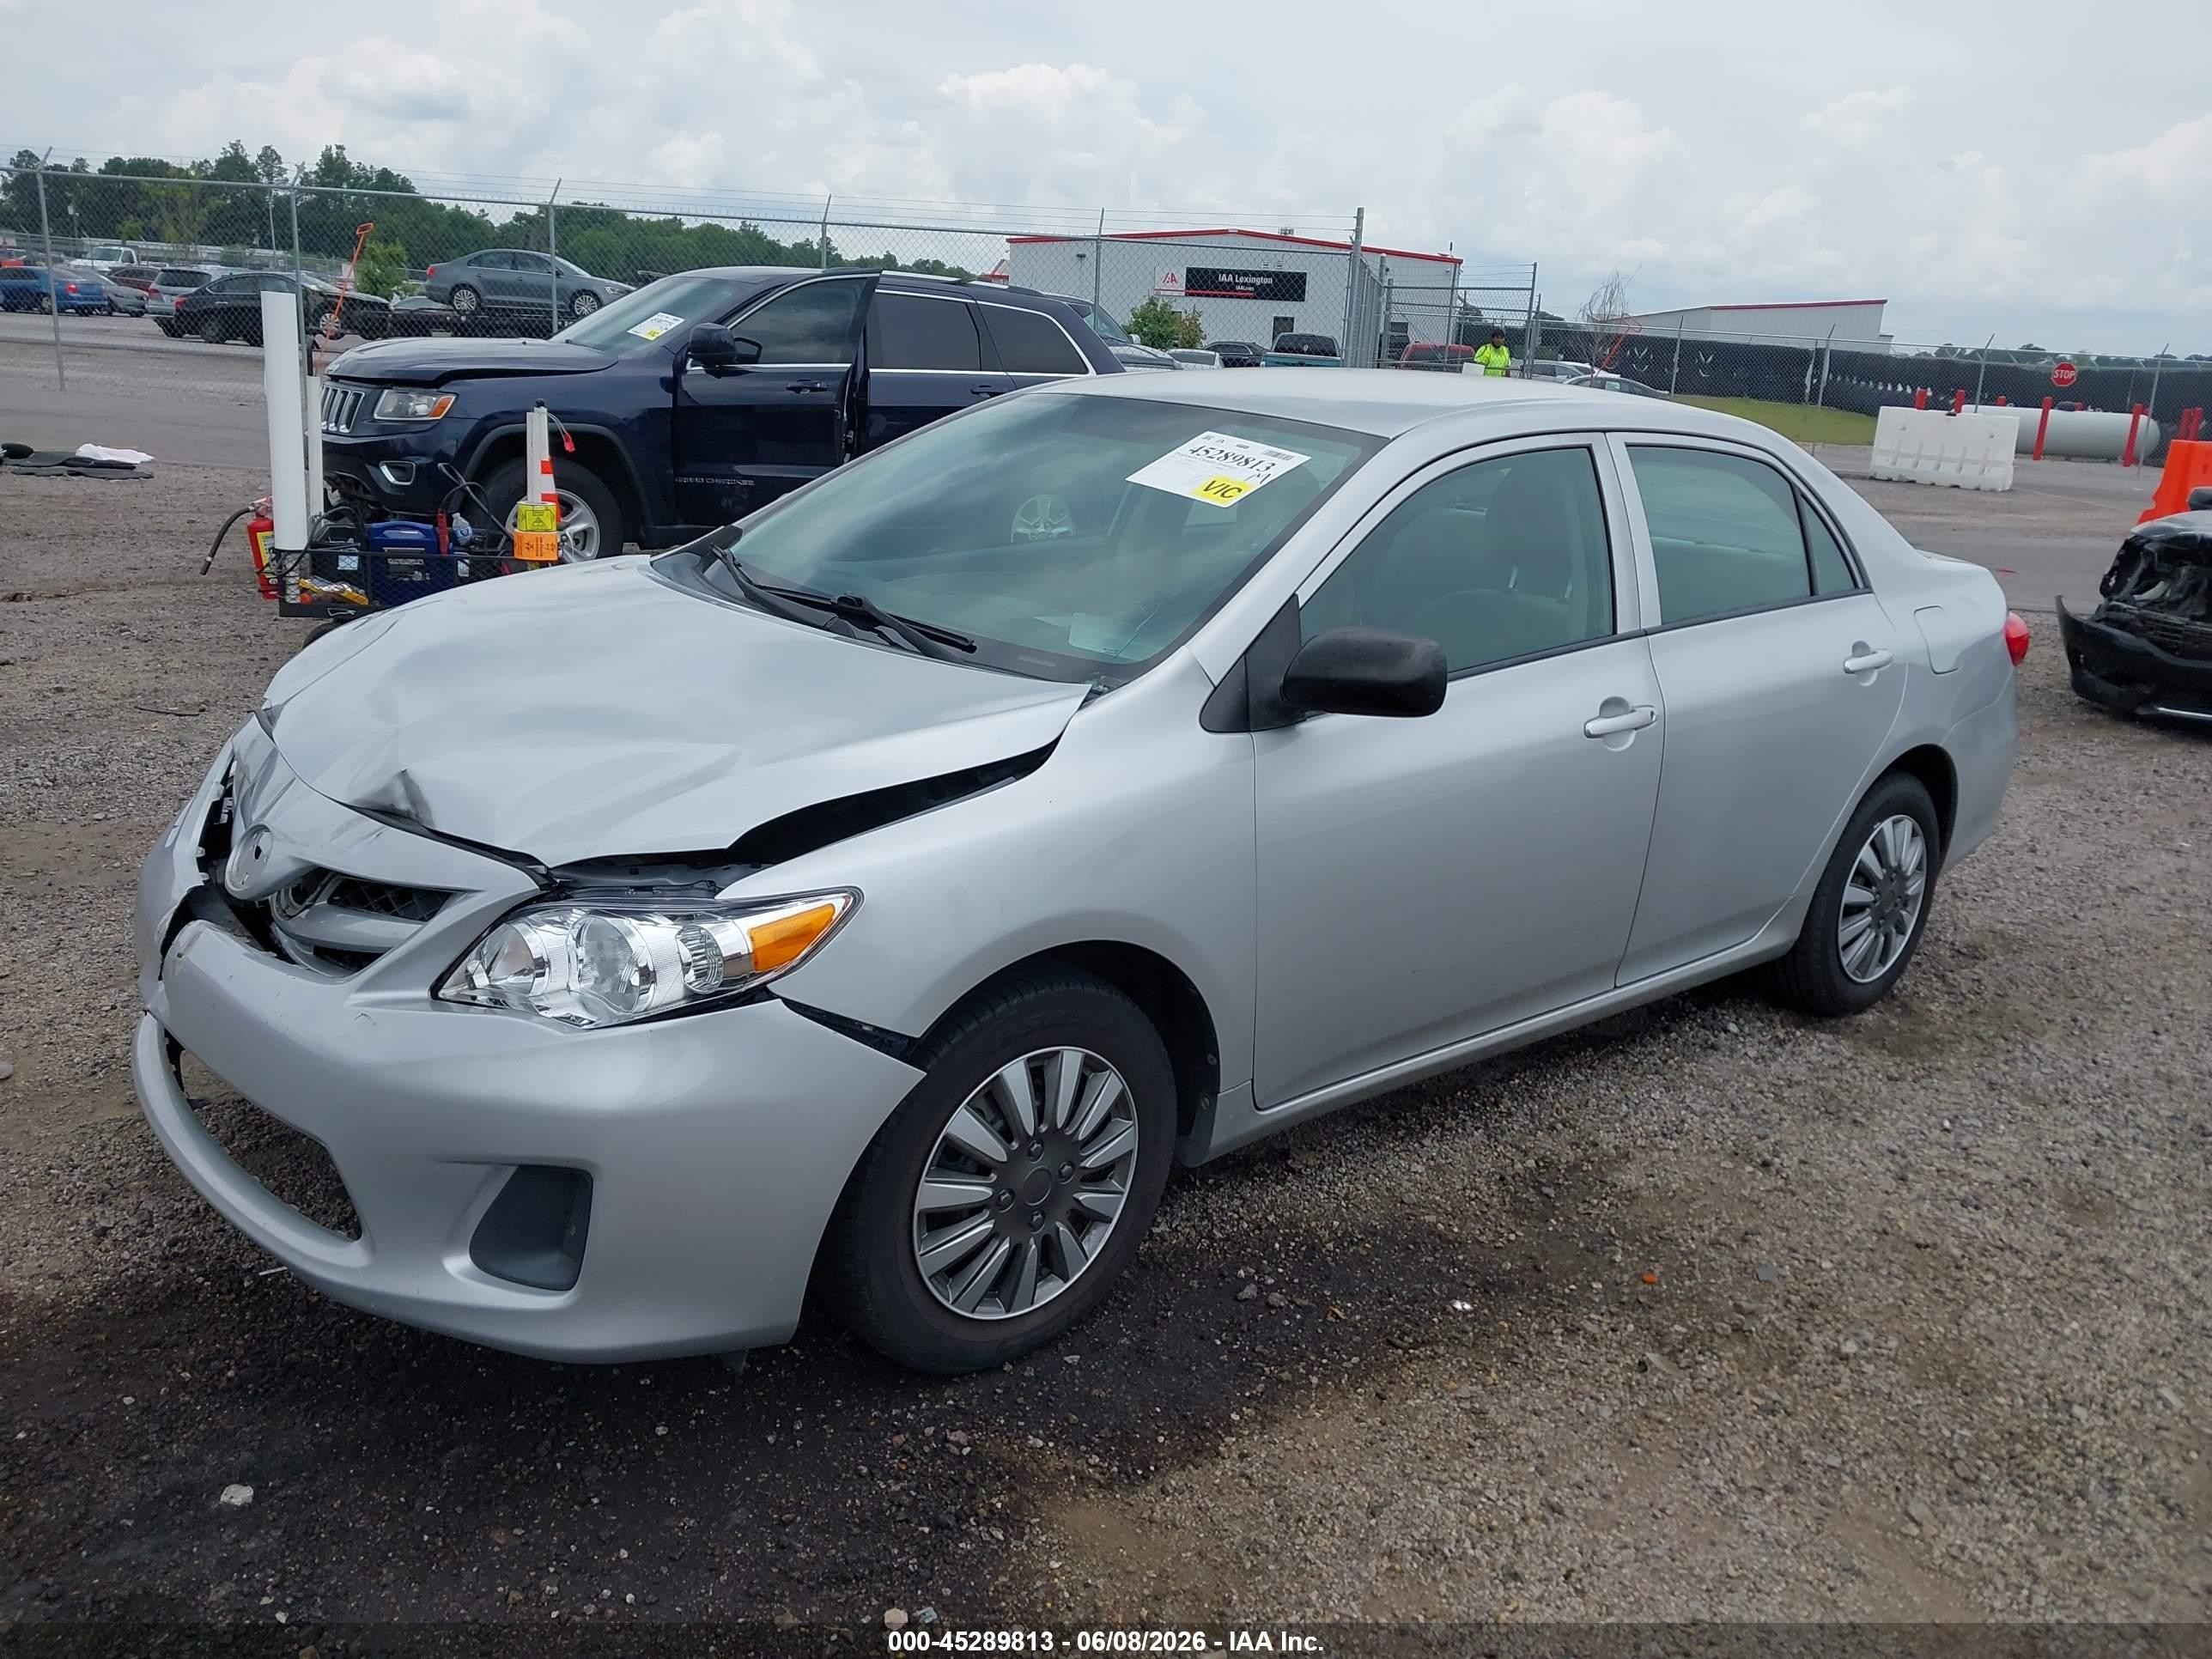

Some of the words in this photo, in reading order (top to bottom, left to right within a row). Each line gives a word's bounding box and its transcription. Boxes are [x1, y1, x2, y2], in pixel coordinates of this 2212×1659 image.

[1218, 274, 1234, 283] IAA
[1236, 275, 1273, 285] Lexington
[2053, 369, 2075, 379] STOP
[1188, 445, 1276, 472] 45289813
[1203, 480, 1243, 498] VIC
